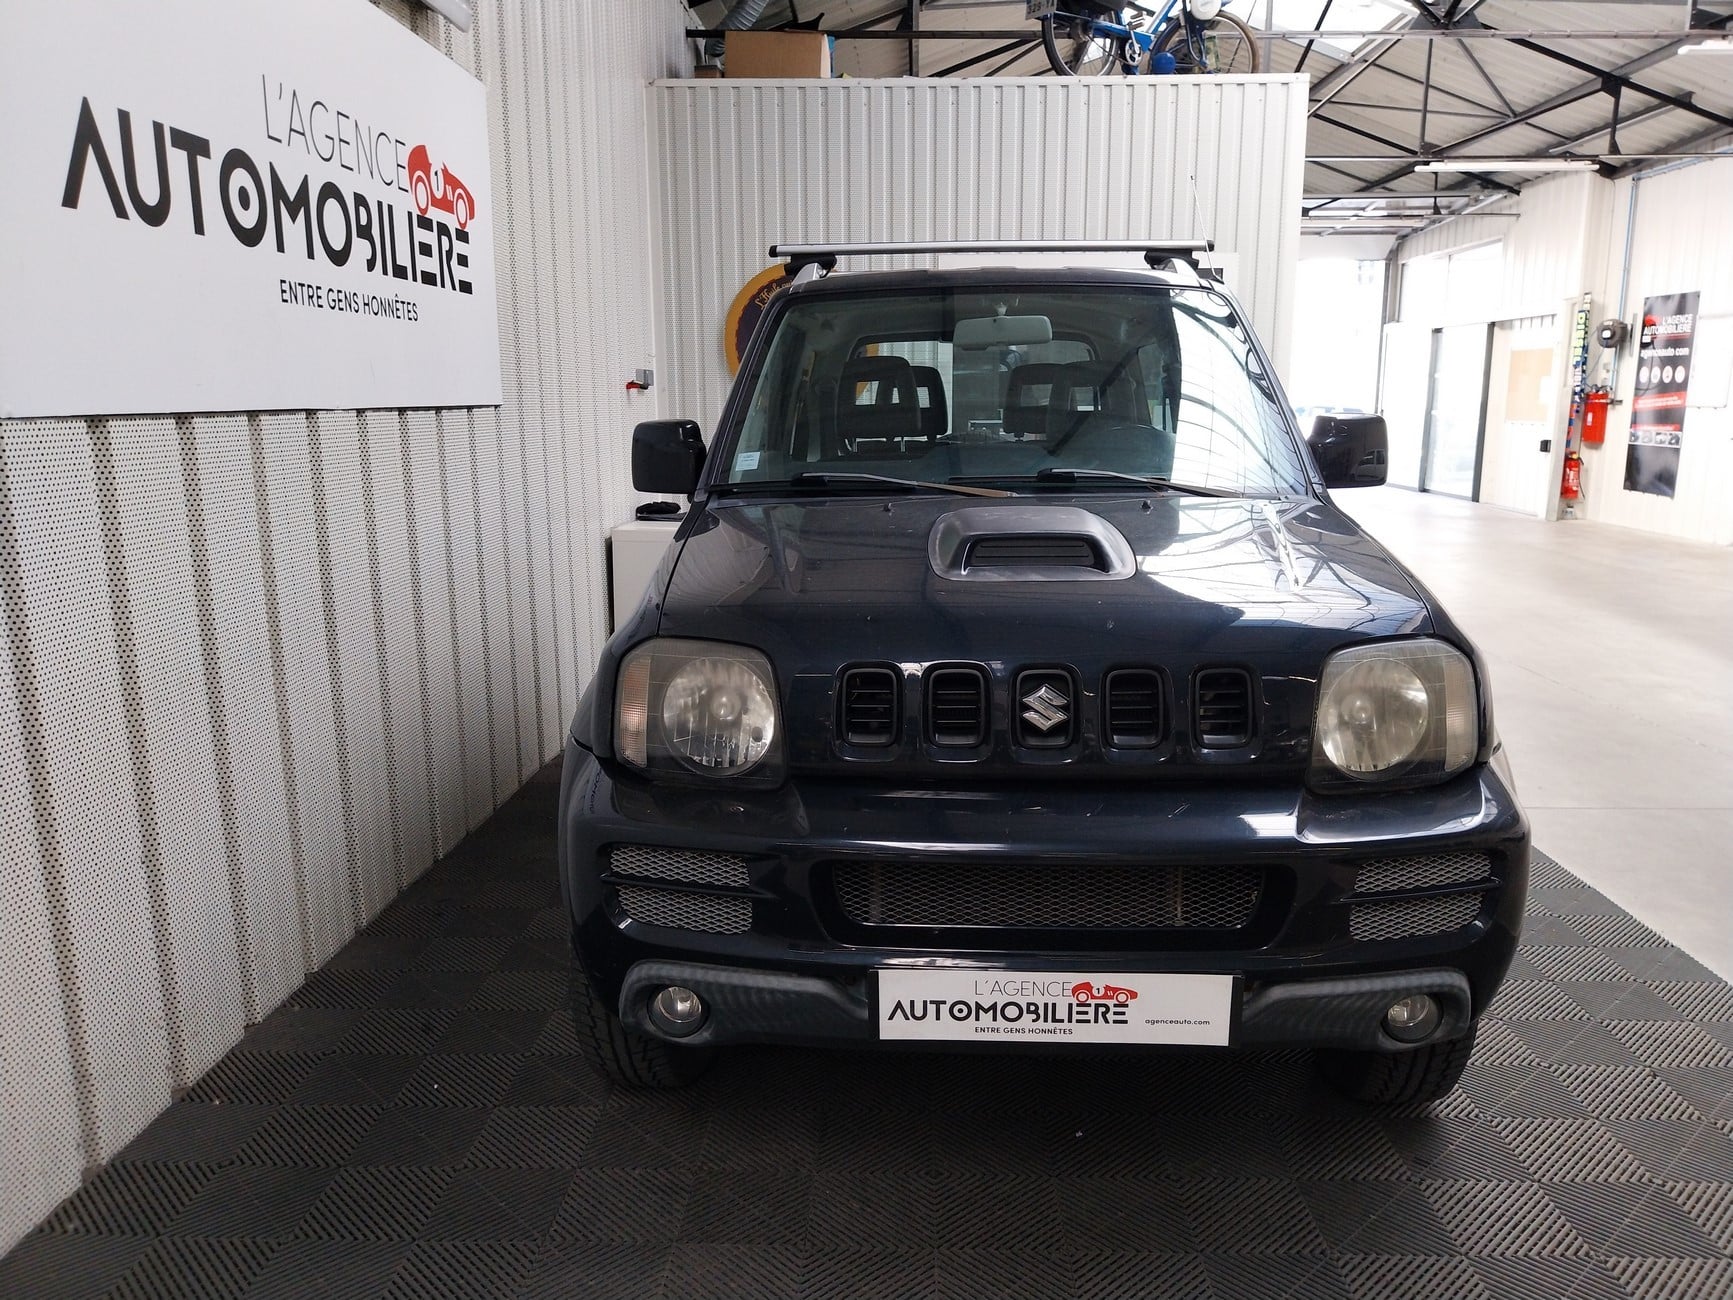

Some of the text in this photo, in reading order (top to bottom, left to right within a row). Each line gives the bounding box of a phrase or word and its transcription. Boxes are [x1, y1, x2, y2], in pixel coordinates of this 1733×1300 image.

[262, 74, 408, 193] L'AGENCE
[61, 96, 473, 295] AUTOMOBILIERE
[280, 279, 419, 322] ENTRE GENS HONNÊTES
[974, 980, 1072, 997] L'AGENCE
[887, 999, 1129, 1025] AUTOMOBILIERE
[1144, 1018, 1211, 1026] agenceauto.com
[974, 1026, 1073, 1036] ENTRE GENS HONNÊTES
